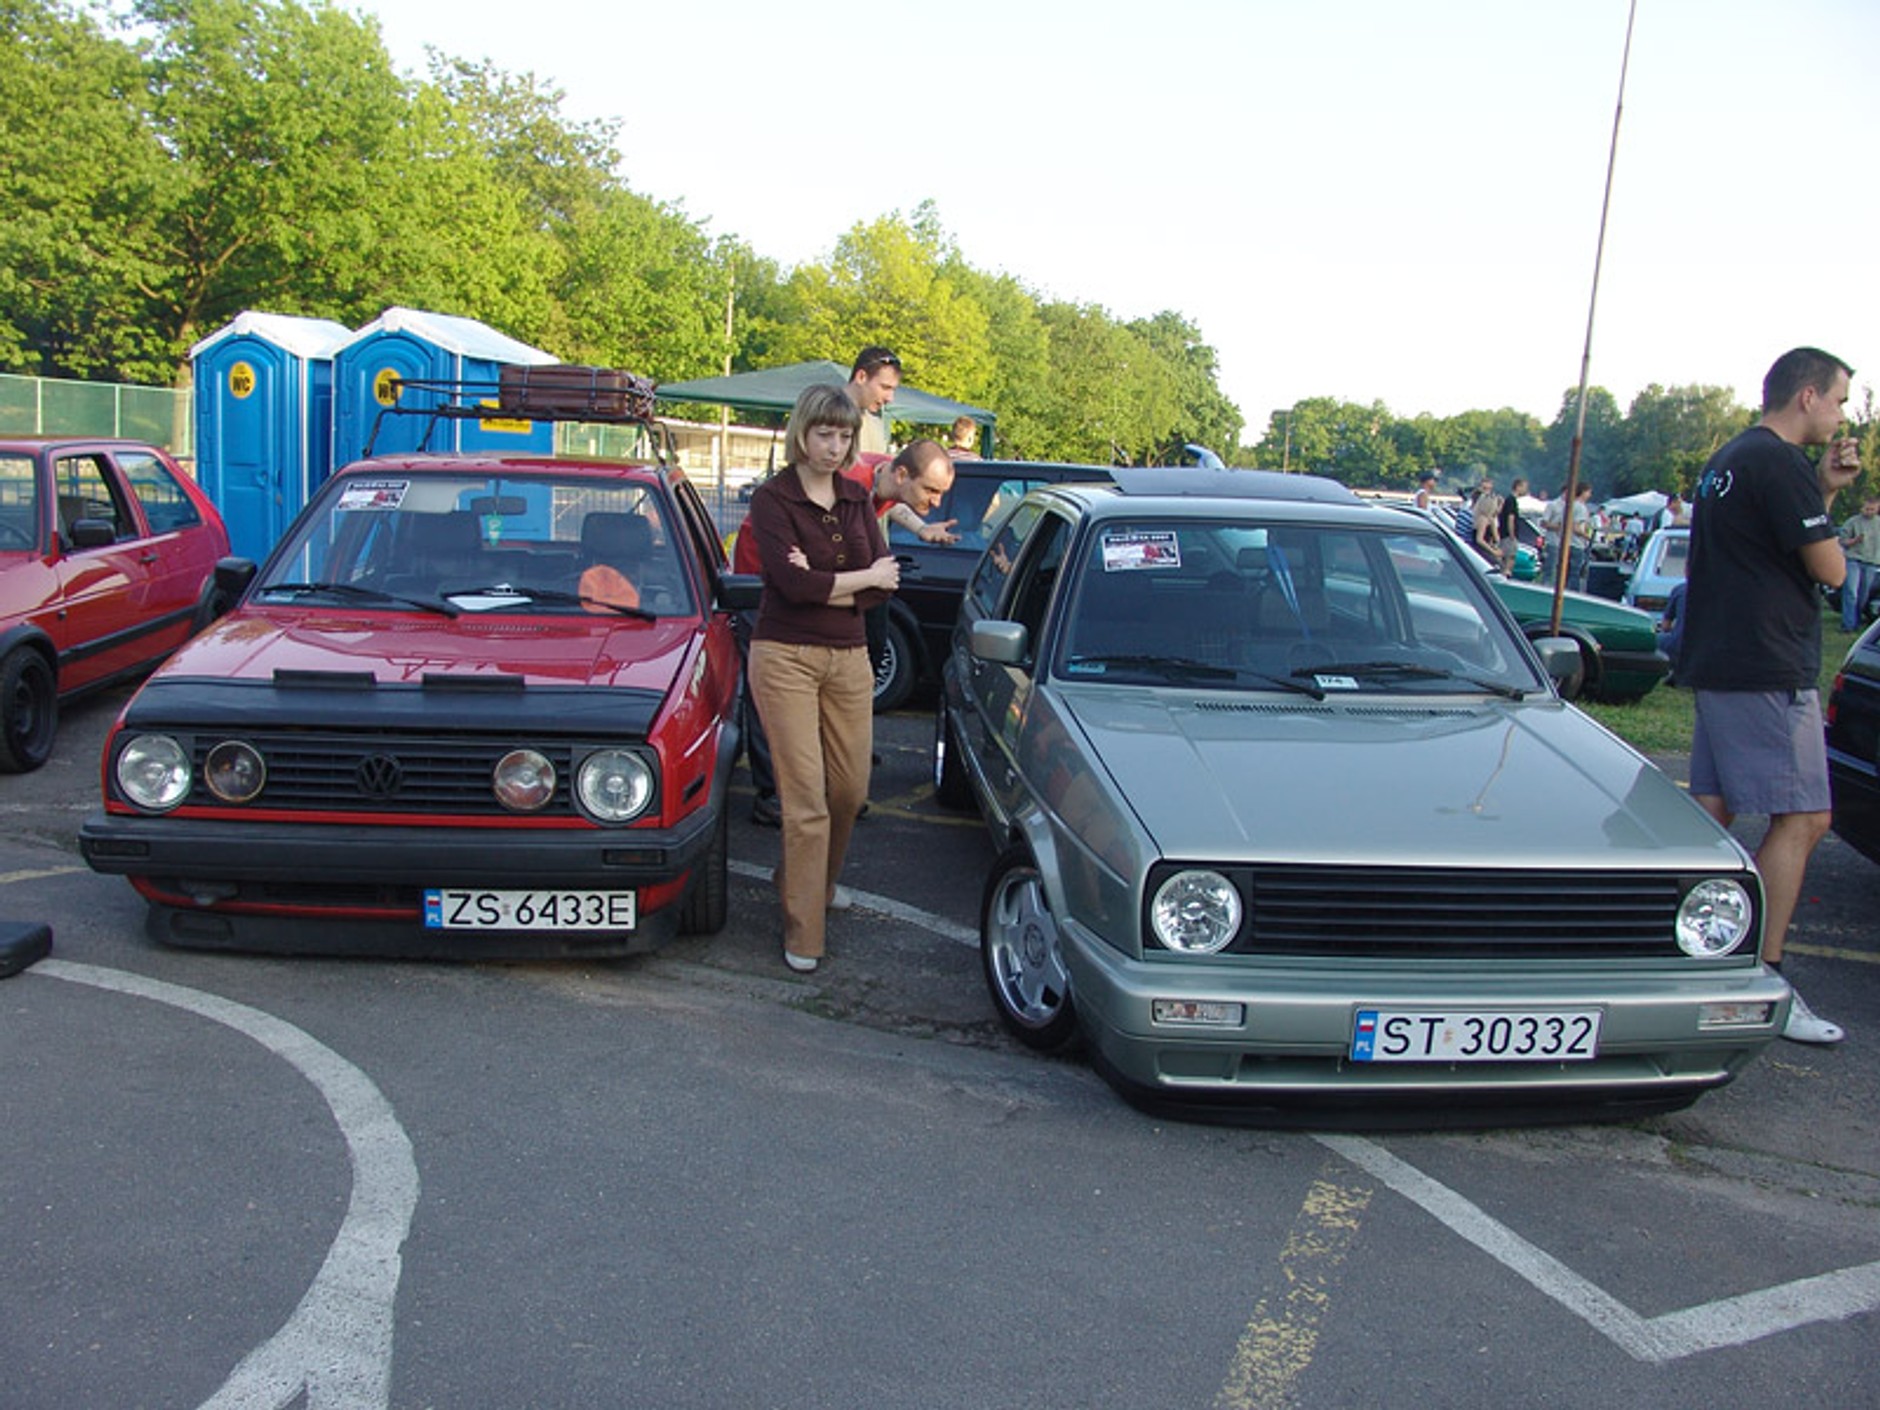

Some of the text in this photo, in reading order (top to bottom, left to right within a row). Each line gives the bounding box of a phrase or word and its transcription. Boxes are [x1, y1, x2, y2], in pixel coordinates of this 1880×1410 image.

[232, 375, 250, 391] WC
[447, 893, 630, 926] ZS 6433E
[1356, 1041, 1371, 1052] PL
[1382, 1017, 1592, 1055] ST 30332
